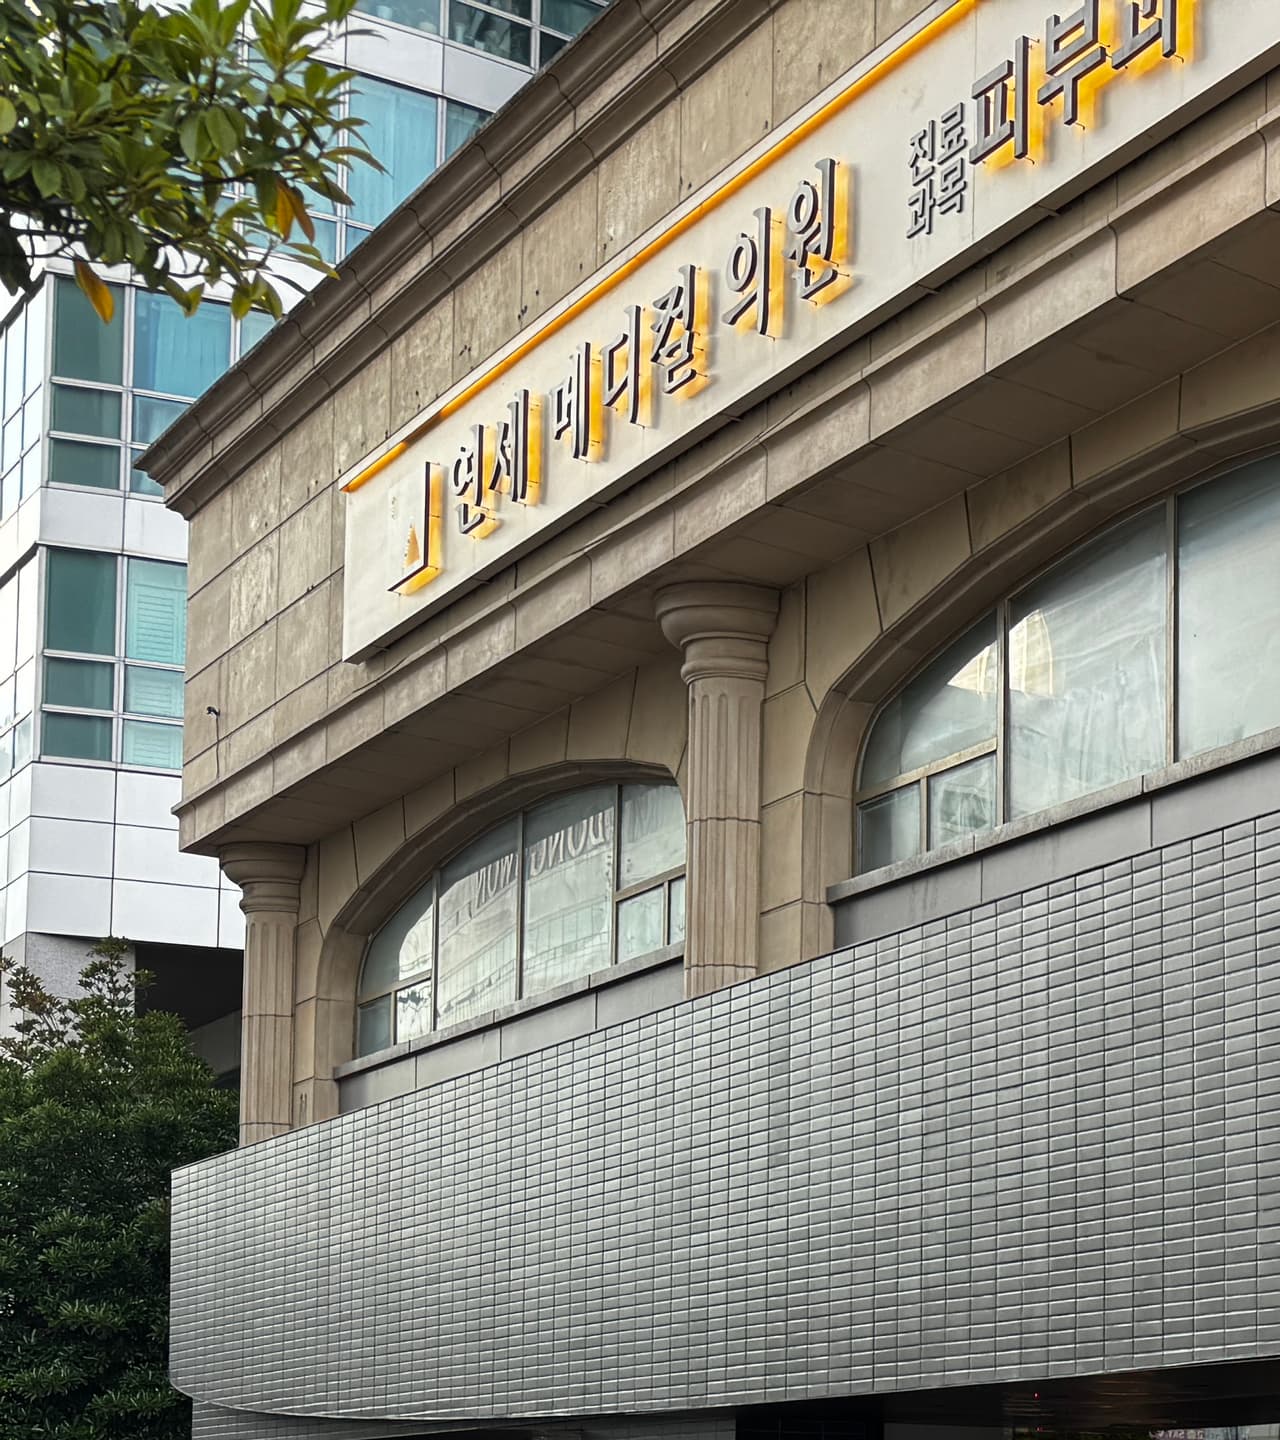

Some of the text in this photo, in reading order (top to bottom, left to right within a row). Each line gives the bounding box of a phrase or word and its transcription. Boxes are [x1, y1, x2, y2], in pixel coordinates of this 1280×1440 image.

[908, 102, 968, 187] 진료
[906, 157, 967, 239] 과목
[452, 158, 839, 534] 연세 메디컬 의원
